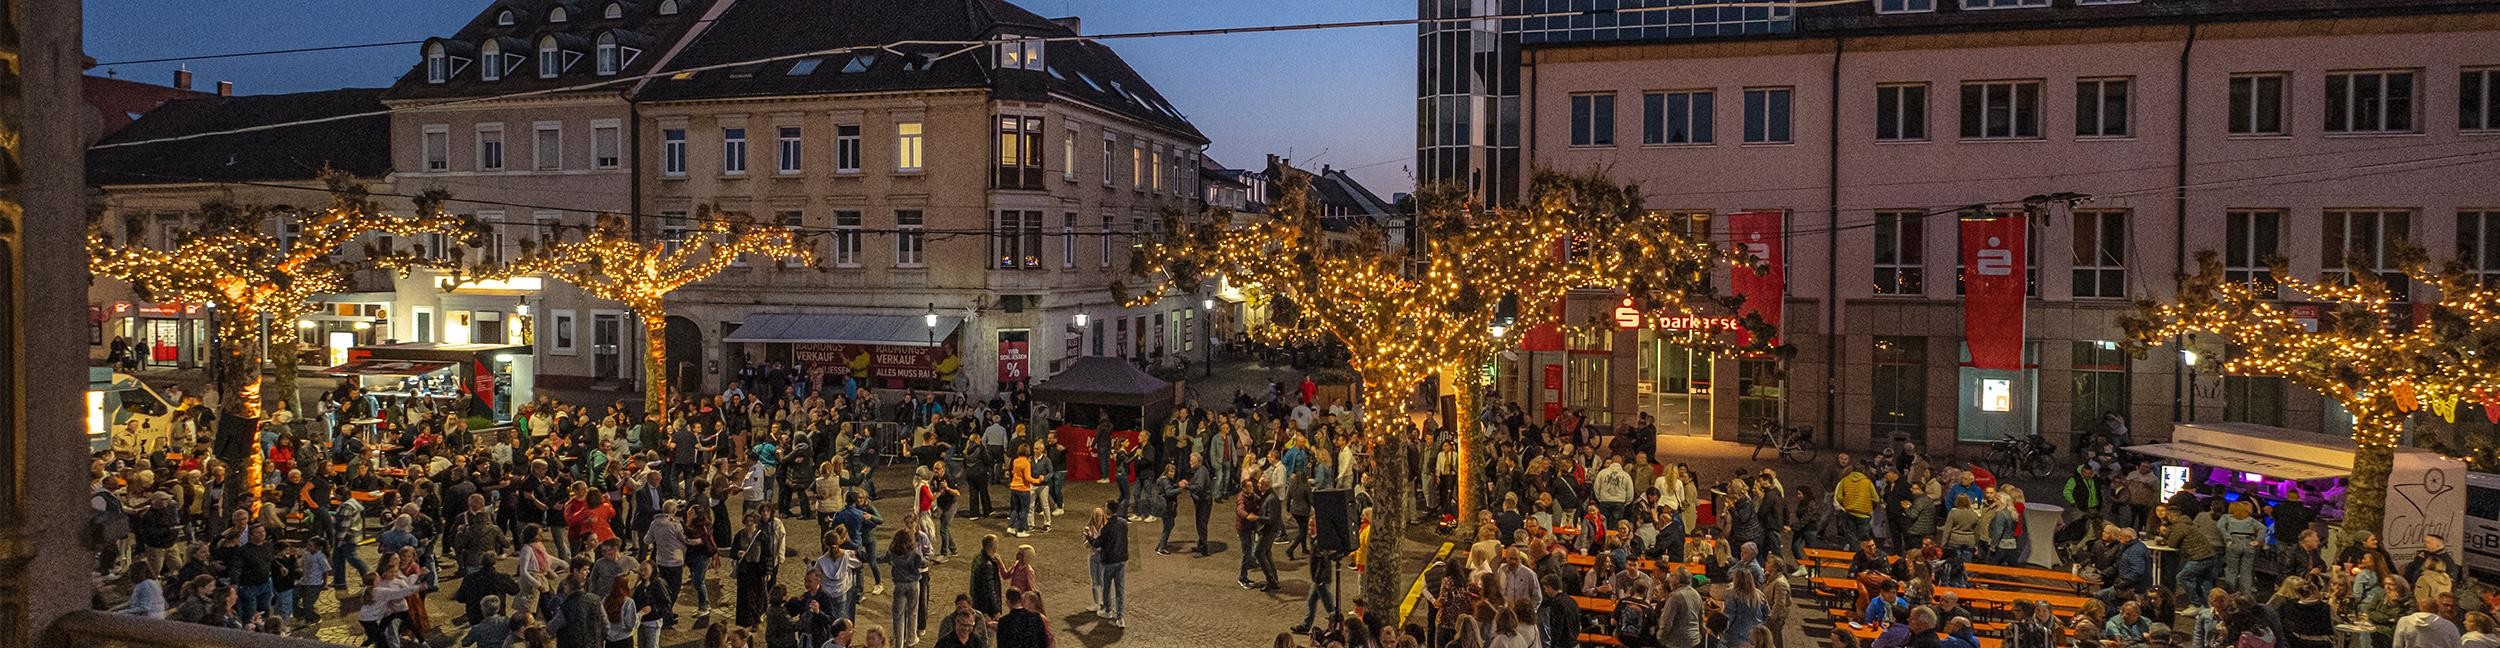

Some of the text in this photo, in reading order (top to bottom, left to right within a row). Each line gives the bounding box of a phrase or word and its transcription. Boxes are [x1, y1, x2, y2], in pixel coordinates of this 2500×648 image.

[795, 351, 835, 362] VERKAUF
[876, 354, 917, 365] VERKAUF
[876, 368, 897, 377] ALLES
[897, 369, 918, 378] MUSS
[1006, 362, 1021, 378] %
